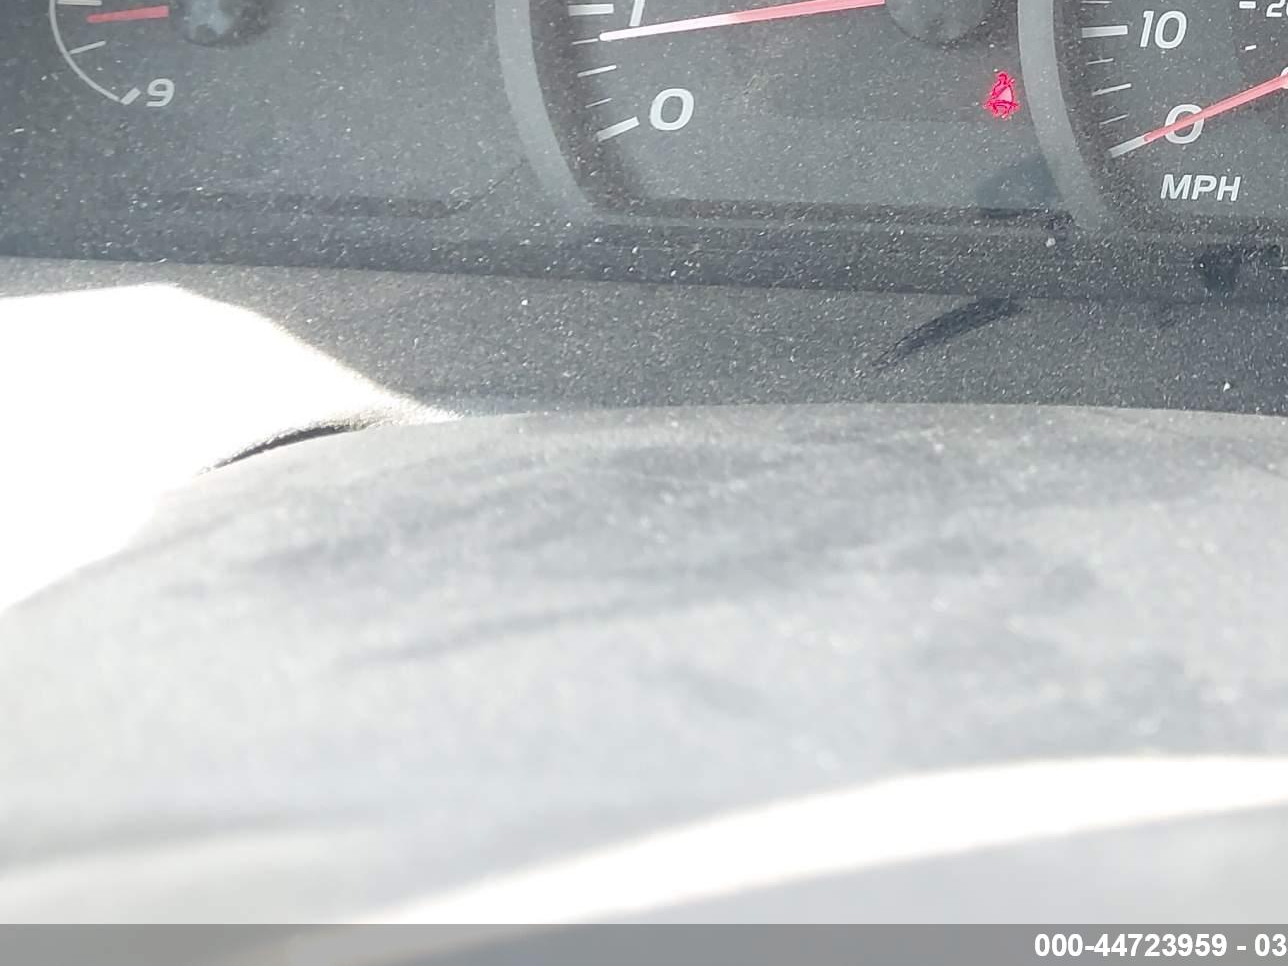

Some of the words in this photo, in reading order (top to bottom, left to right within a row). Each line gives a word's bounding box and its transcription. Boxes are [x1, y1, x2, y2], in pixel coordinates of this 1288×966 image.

[1139, 11, 1187, 48] 10
[146, 79, 174, 106] 9
[649, 89, 694, 131] 0
[1165, 105, 1203, 144] 0
[1160, 176, 1240, 202] MPH
